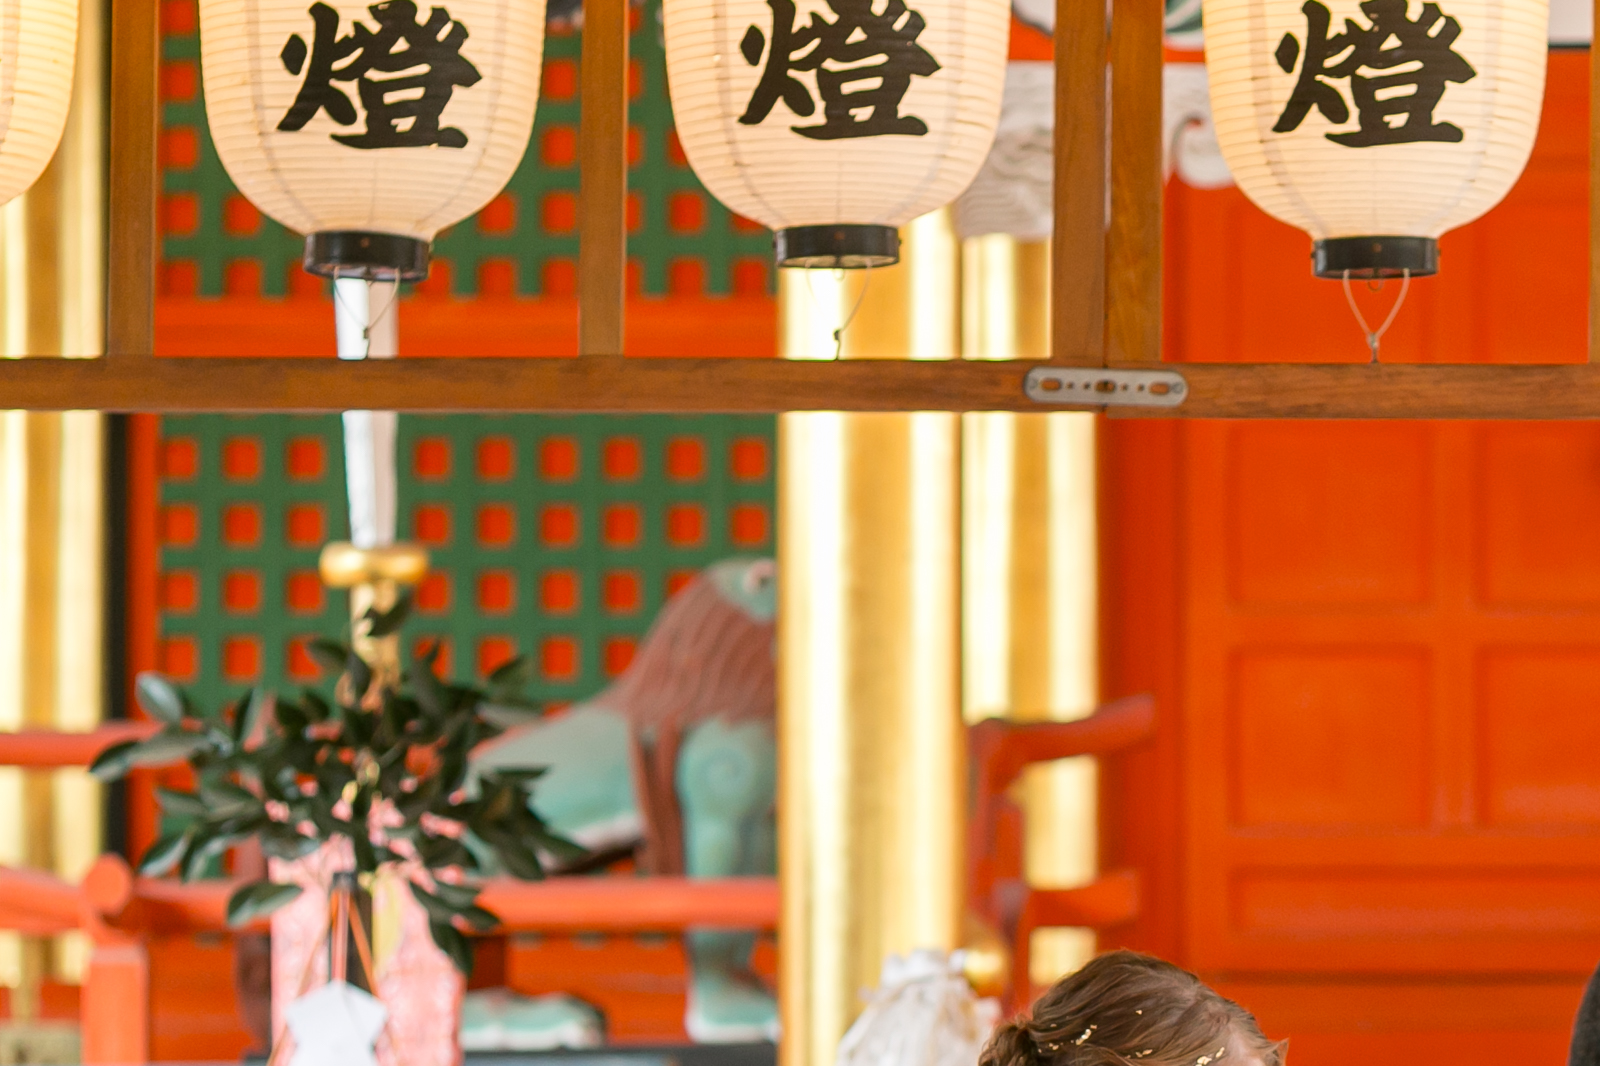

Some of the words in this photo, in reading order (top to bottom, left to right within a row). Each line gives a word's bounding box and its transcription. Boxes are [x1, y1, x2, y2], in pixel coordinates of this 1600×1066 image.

[277, 0, 483, 150] 燈
[738, 0, 942, 141] 燈
[1272, 0, 1476, 148] 燈
